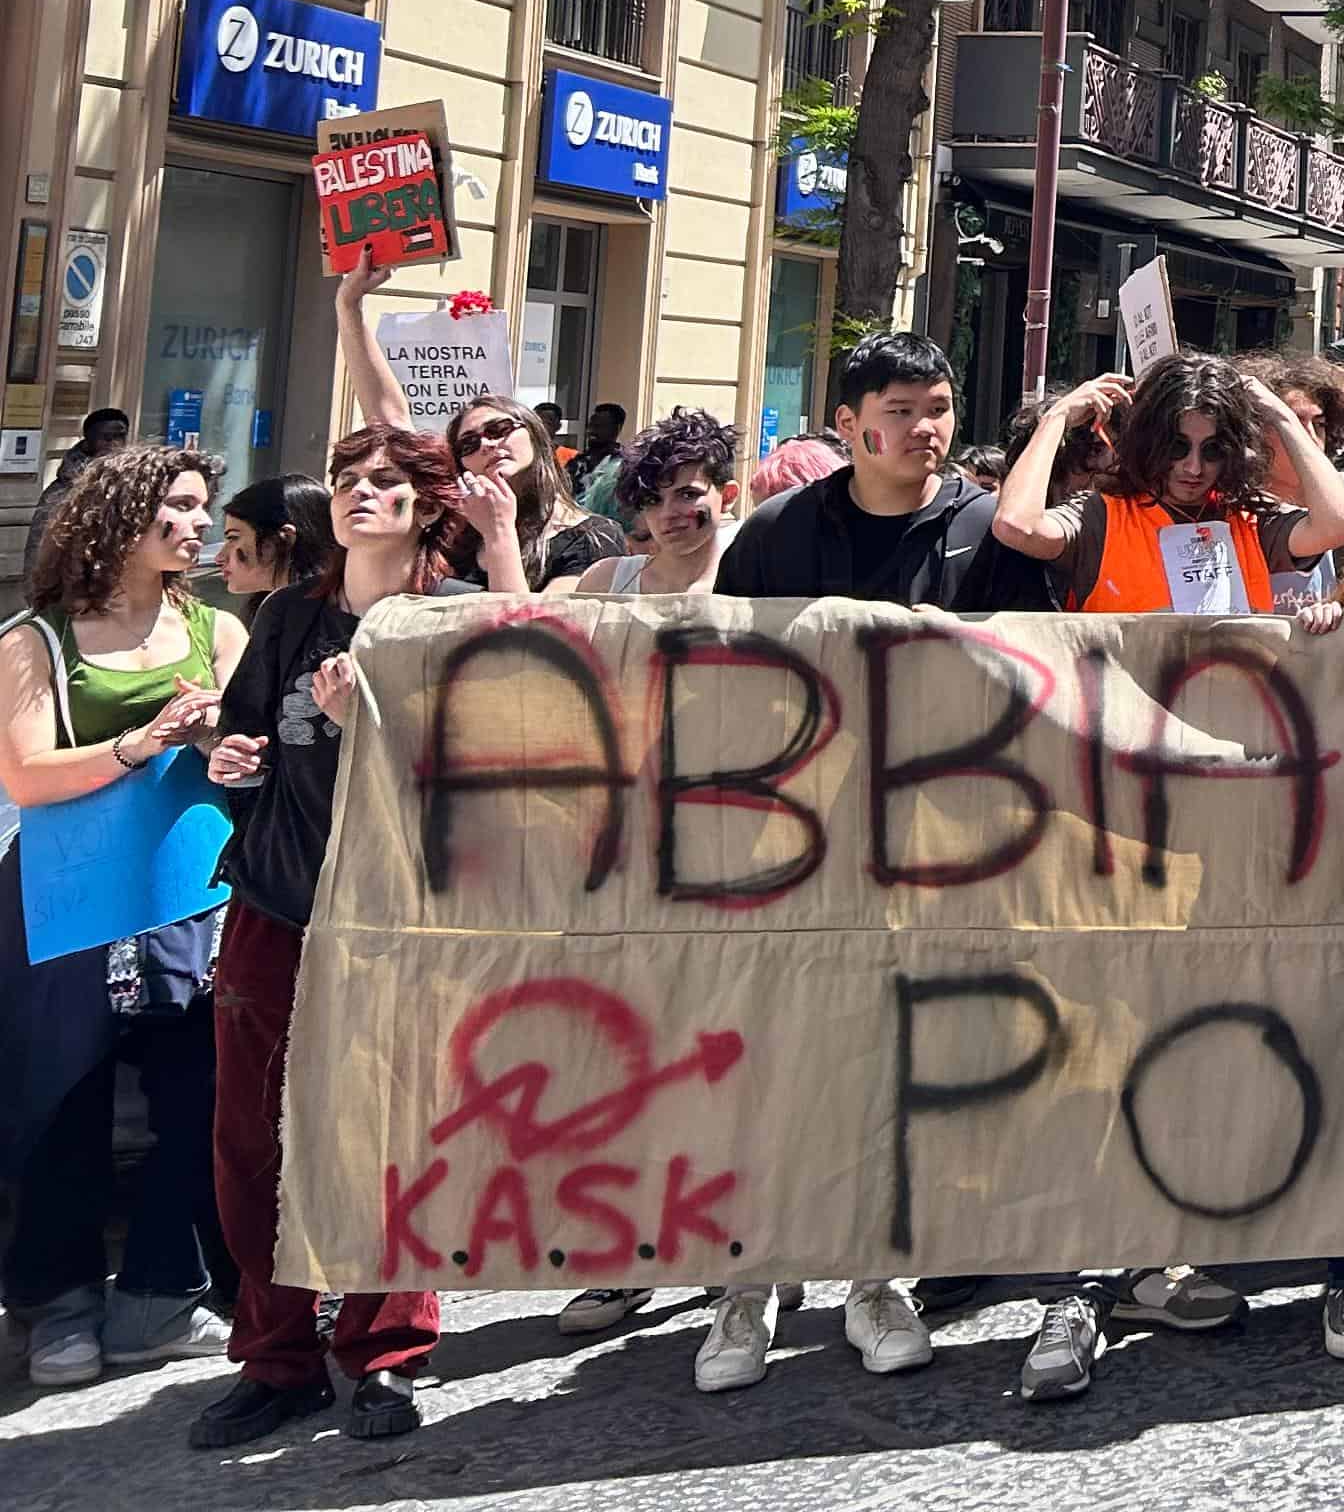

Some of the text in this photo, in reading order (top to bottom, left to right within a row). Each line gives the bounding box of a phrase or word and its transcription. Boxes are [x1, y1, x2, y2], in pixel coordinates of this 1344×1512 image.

[263, 32, 365, 86] ZURICH
[595, 110, 662, 152] ZURICH
[314, 139, 434, 197] PALESTINA
[330, 178, 442, 246] LIBERA
[387, 346, 487, 361] LA NOSTRA
[408, 365, 468, 379] TERRA
[438, 380, 448, 397] È
[454, 383, 490, 397] UNA
[1183, 566, 1233, 583] STAFF
[379, 1152, 746, 1280] K.A.S.K.
